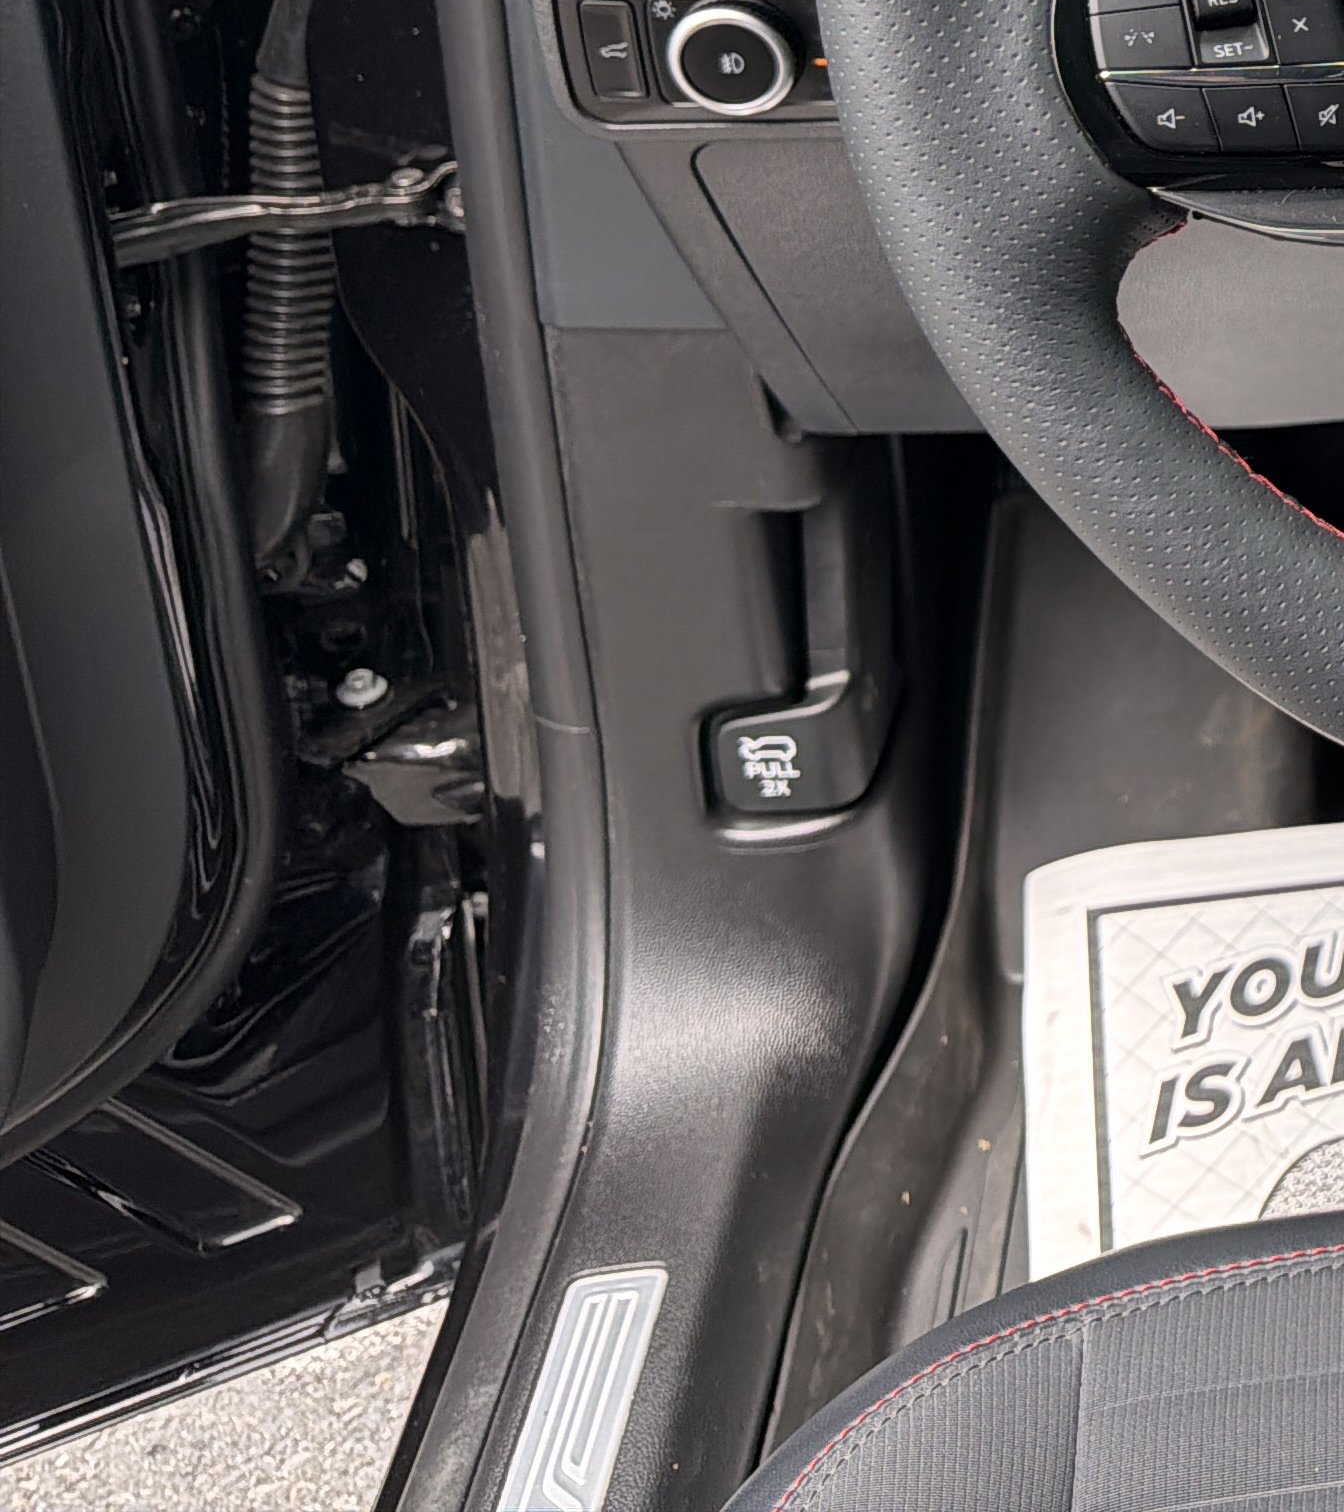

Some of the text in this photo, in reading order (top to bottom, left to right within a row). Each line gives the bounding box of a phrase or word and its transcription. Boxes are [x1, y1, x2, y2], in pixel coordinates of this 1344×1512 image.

[1212, 42, 1255, 59] SET-
[743, 761, 801, 780] PULL
[758, 779, 792, 799] 2X
[1148, 1061, 1238, 1144] IS
